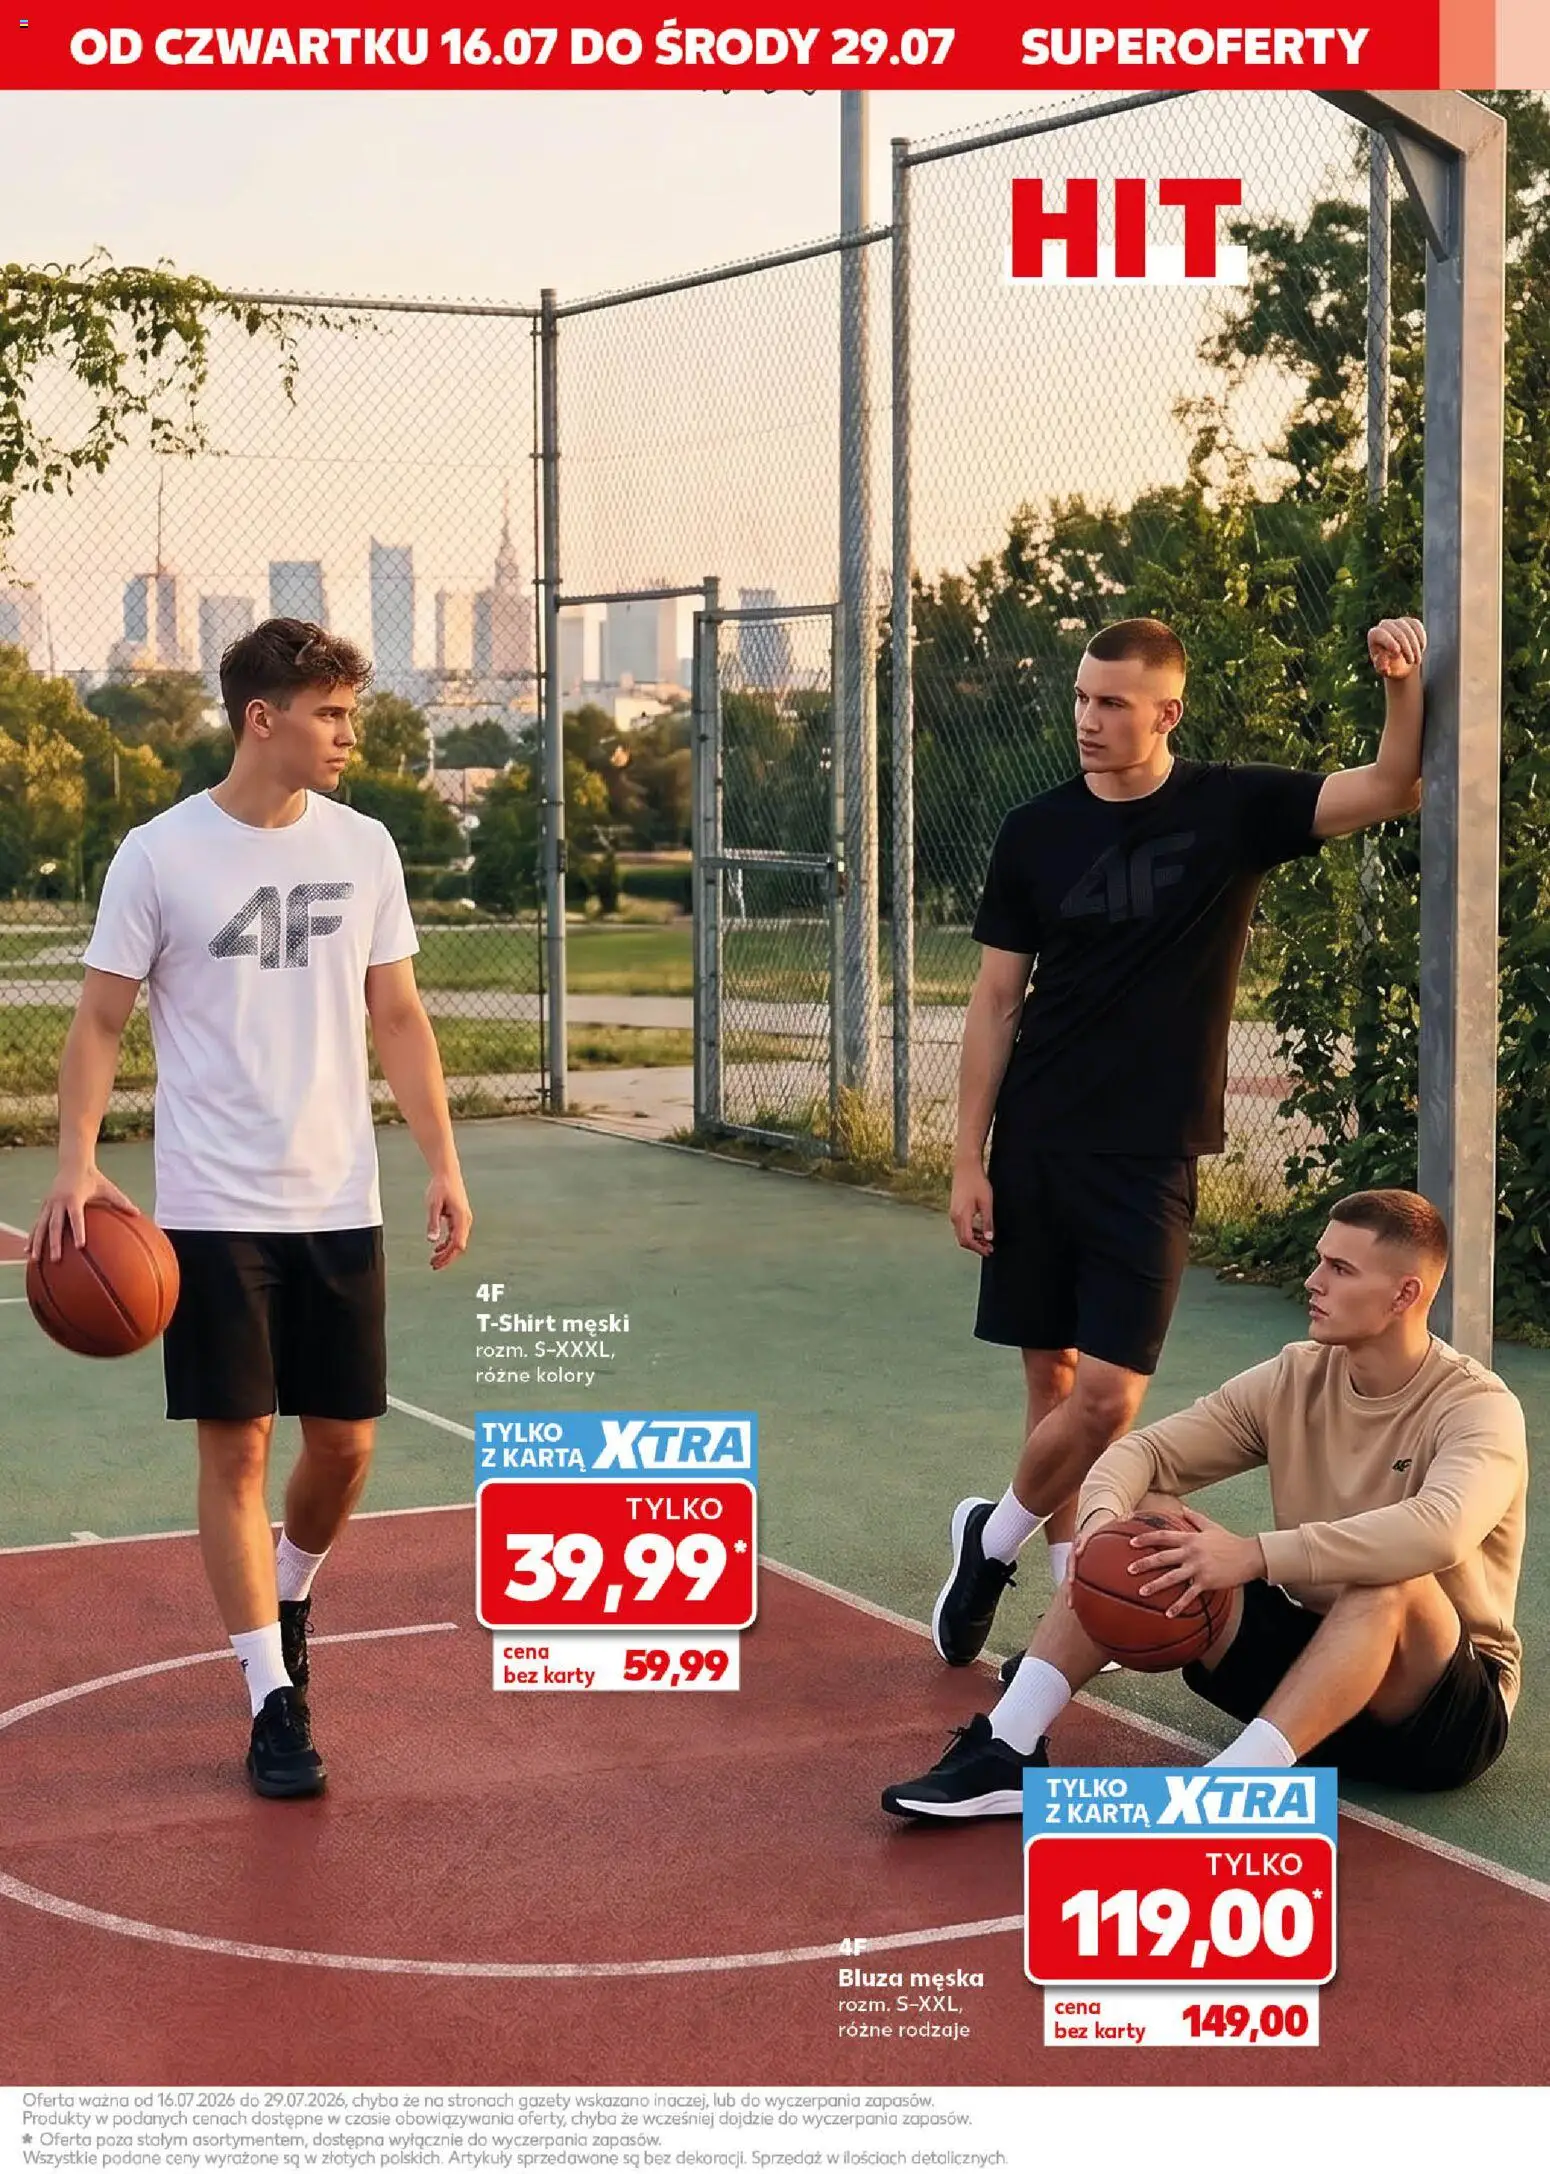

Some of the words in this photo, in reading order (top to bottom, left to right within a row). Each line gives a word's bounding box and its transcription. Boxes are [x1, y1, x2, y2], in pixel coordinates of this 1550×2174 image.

[71, 28, 142, 65] OD
[155, 28, 428, 65] CZWARTKU
[441, 28, 557, 65] 16.07
[571, 28, 643, 65] DO
[655, 18, 820, 65] ŚRODY
[831, 28, 955, 65] 29.07
[1022, 28, 1370, 65] SUPEROFERTY
[1012, 178, 1242, 277] HIT
[1060, 831, 1196, 922] 4F
[208, 882, 355, 969] 4F
[476, 1283, 505, 1303] 4F
[476, 1313, 557, 1333] T-Shirt
[562, 1313, 630, 1337] męski
[476, 1345, 528, 1358] rozm.
[476, 1366, 531, 1383] różne
[537, 1366, 595, 1387] kolory
[482, 1422, 563, 1443] TYLKO
[592, 1420, 750, 1469] XTRA
[482, 1448, 496, 1468] Z
[503, 1448, 586, 1473] KARTĄ
[626, 1497, 723, 1520] TYLKO
[503, 1645, 549, 1660] cena
[503, 1664, 538, 1684] bez
[543, 1664, 596, 1688] karty
[623, 1648, 730, 1687] 59,99
[1046, 1778, 1128, 1798] TYLKO
[1157, 1775, 1315, 1825] XTRA
[1045, 1803, 1060, 1823] Z
[1068, 1803, 1151, 1828] KARTĄ
[1206, 1853, 1303, 1876] TYLKO
[838, 1937, 868, 1957] 4F
[838, 1968, 904, 1988] Bluza
[910, 1968, 985, 1990] męska
[838, 2000, 891, 2013] rozm.
[1054, 2001, 1101, 2016] cena
[838, 2020, 893, 2038] różne
[899, 2020, 970, 2041] rodzaje
[1054, 2020, 1088, 2040] bez
[1094, 2020, 1146, 2044] karty
[1181, 2003, 1310, 2044] 149,00
[22, 2092, 75, 2108] Oferta
[78, 2093, 130, 2108] ważna
[133, 2092, 154, 2108] od
[157, 2091, 236, 2108] 16.07.2026
[239, 2092, 260, 2108] do
[263, 2091, 349, 2110] 29.07.2026,
[351, 2092, 399, 2111] chyba
[402, 2093, 420, 2108] że
[424, 2096, 444, 2109] na
[447, 2092, 514, 2108] stronach
[518, 2092, 571, 2111] gazety
[575, 2092, 651, 2108] wskazano
[654, 2092, 710, 2111] inaczej,
[713, 2092, 736, 2108] lub
[740, 2092, 761, 2108] do
[764, 2092, 861, 2111] wyczerpania
[864, 2092, 935, 2111] zapasów.
[22, 2110, 92, 2130] Produkty
[95, 2114, 109, 2126] w
[112, 2110, 188, 2129] podanych
[192, 2110, 248, 2127] cenach
[250, 2110, 324, 2130] dostępne
[327, 2114, 341, 2125] w
[344, 2112, 391, 2126] czasie
[394, 2109, 514, 2130] obowiązywania
[517, 2109, 568, 2130] oferty,
[570, 2110, 617, 2130] chyba
[620, 2111, 639, 2126] że
[642, 2110, 715, 2130] wcześniej
[718, 2110, 774, 2130] dojdzie
[777, 2110, 799, 2126] do
[801, 2111, 898, 2130] wyczerpania
[901, 2111, 973, 2129] zapasów.
[39, 2131, 92, 2147] Oferta
[96, 2135, 134, 2151] poza
[136, 2131, 188, 2150] stałym
[192, 2132, 309, 2150] asortymentem,
[312, 2131, 385, 2150] dostępna
[388, 2132, 464, 2150] wyłącznie
[467, 2131, 488, 2147] do
[491, 2132, 588, 2150] wyczerpania
[591, 2132, 662, 2151] zapasów.
[22, 2149, 98, 2169] Wszystkie
[102, 2150, 162, 2169] podane
[165, 2153, 201, 2169] ceny
[204, 2151, 280, 2169] wyrażone
[283, 2153, 300, 2169] są
[303, 2153, 318, 2165] w
[321, 2150, 376, 2169] złotych
[380, 2149, 444, 2169] polskich.
[447, 2150, 514, 2169] Artykuły
[516, 2150, 619, 2169] sprzedawane
[622, 2153, 640, 2169] są
[643, 2150, 672, 2166] bez
[675, 2150, 748, 2169] dekoracji.
[751, 2149, 823, 2169] Sprzedaż
[826, 2153, 840, 2165] w
[843, 2150, 907, 2166] ilościach
[911, 2149, 1008, 2169] detalicznych.
